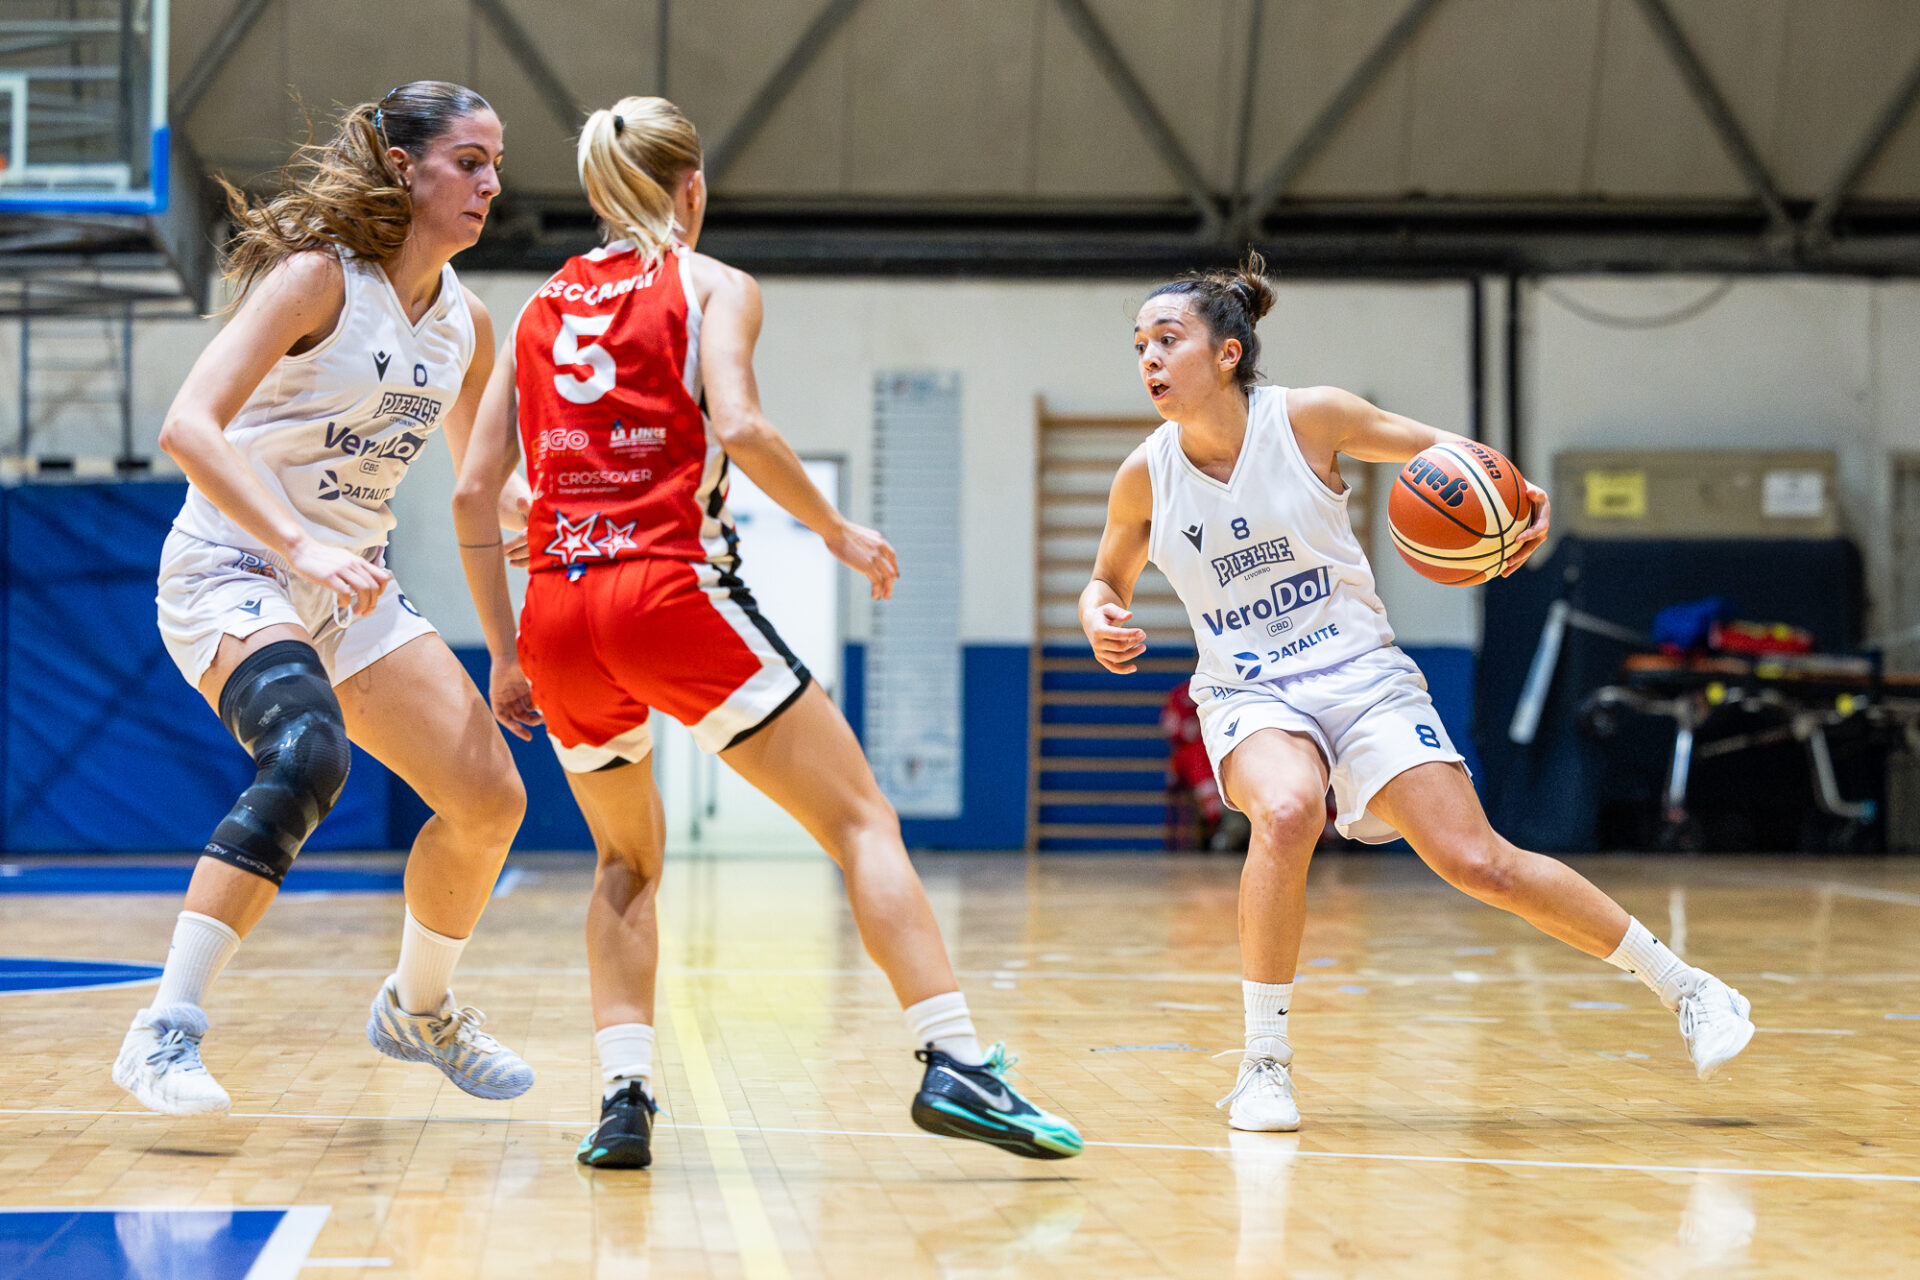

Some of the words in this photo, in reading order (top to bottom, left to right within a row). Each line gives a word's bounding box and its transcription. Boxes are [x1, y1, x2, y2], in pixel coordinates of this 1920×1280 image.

[552, 313, 616, 404] 5
[413, 363, 428, 387] 0
[372, 391, 442, 427] PIELLE
[558, 469, 653, 486] CROSSOVER
[1408, 456, 1468, 508] gala
[1231, 517, 1250, 540] 8
[1210, 536, 1295, 588] PIELLE
[1243, 566, 1271, 581] LIVORNO
[1202, 565, 1331, 636] VeroDol
[1268, 618, 1291, 635] CBD
[1267, 623, 1340, 663] DATALITE
[1415, 723, 1441, 749] 8
